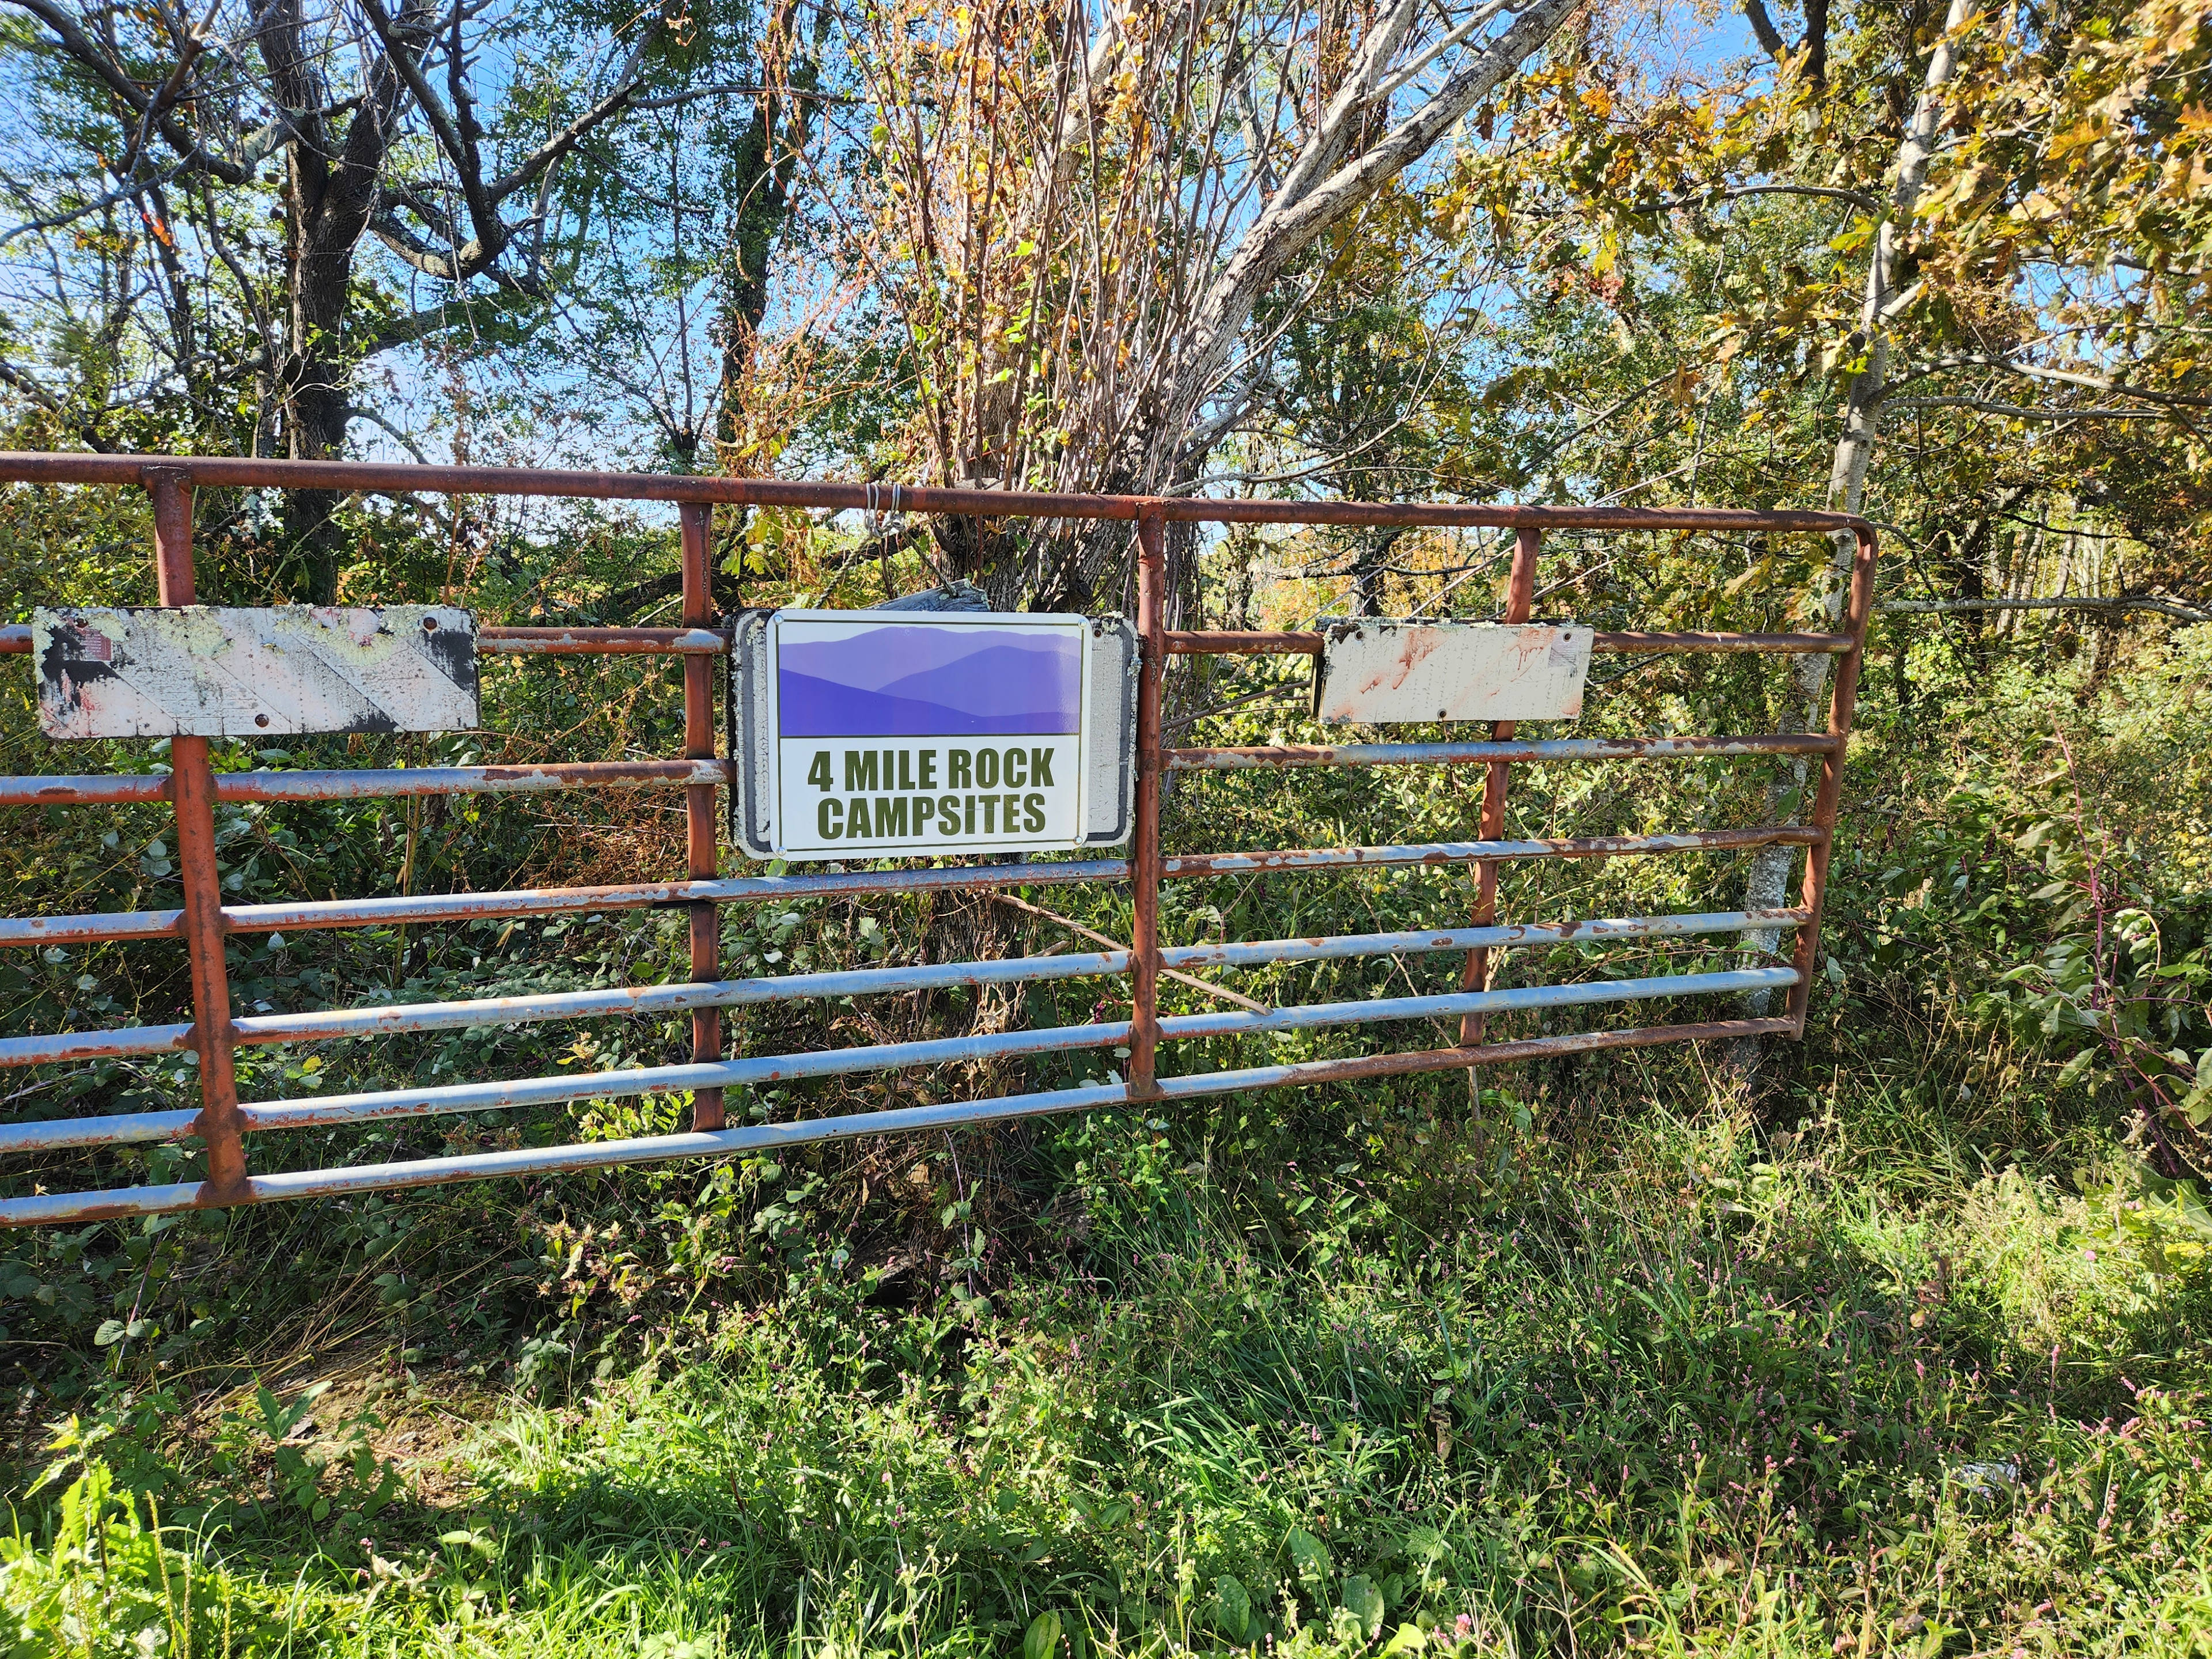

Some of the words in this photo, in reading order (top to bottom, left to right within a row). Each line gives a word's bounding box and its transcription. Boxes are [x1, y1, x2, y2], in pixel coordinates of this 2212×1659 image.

[808, 751, 834, 792] 4
[844, 749, 937, 791] MILE
[948, 748, 1055, 789] ROCK
[817, 793, 1046, 840] CAMPSITES
